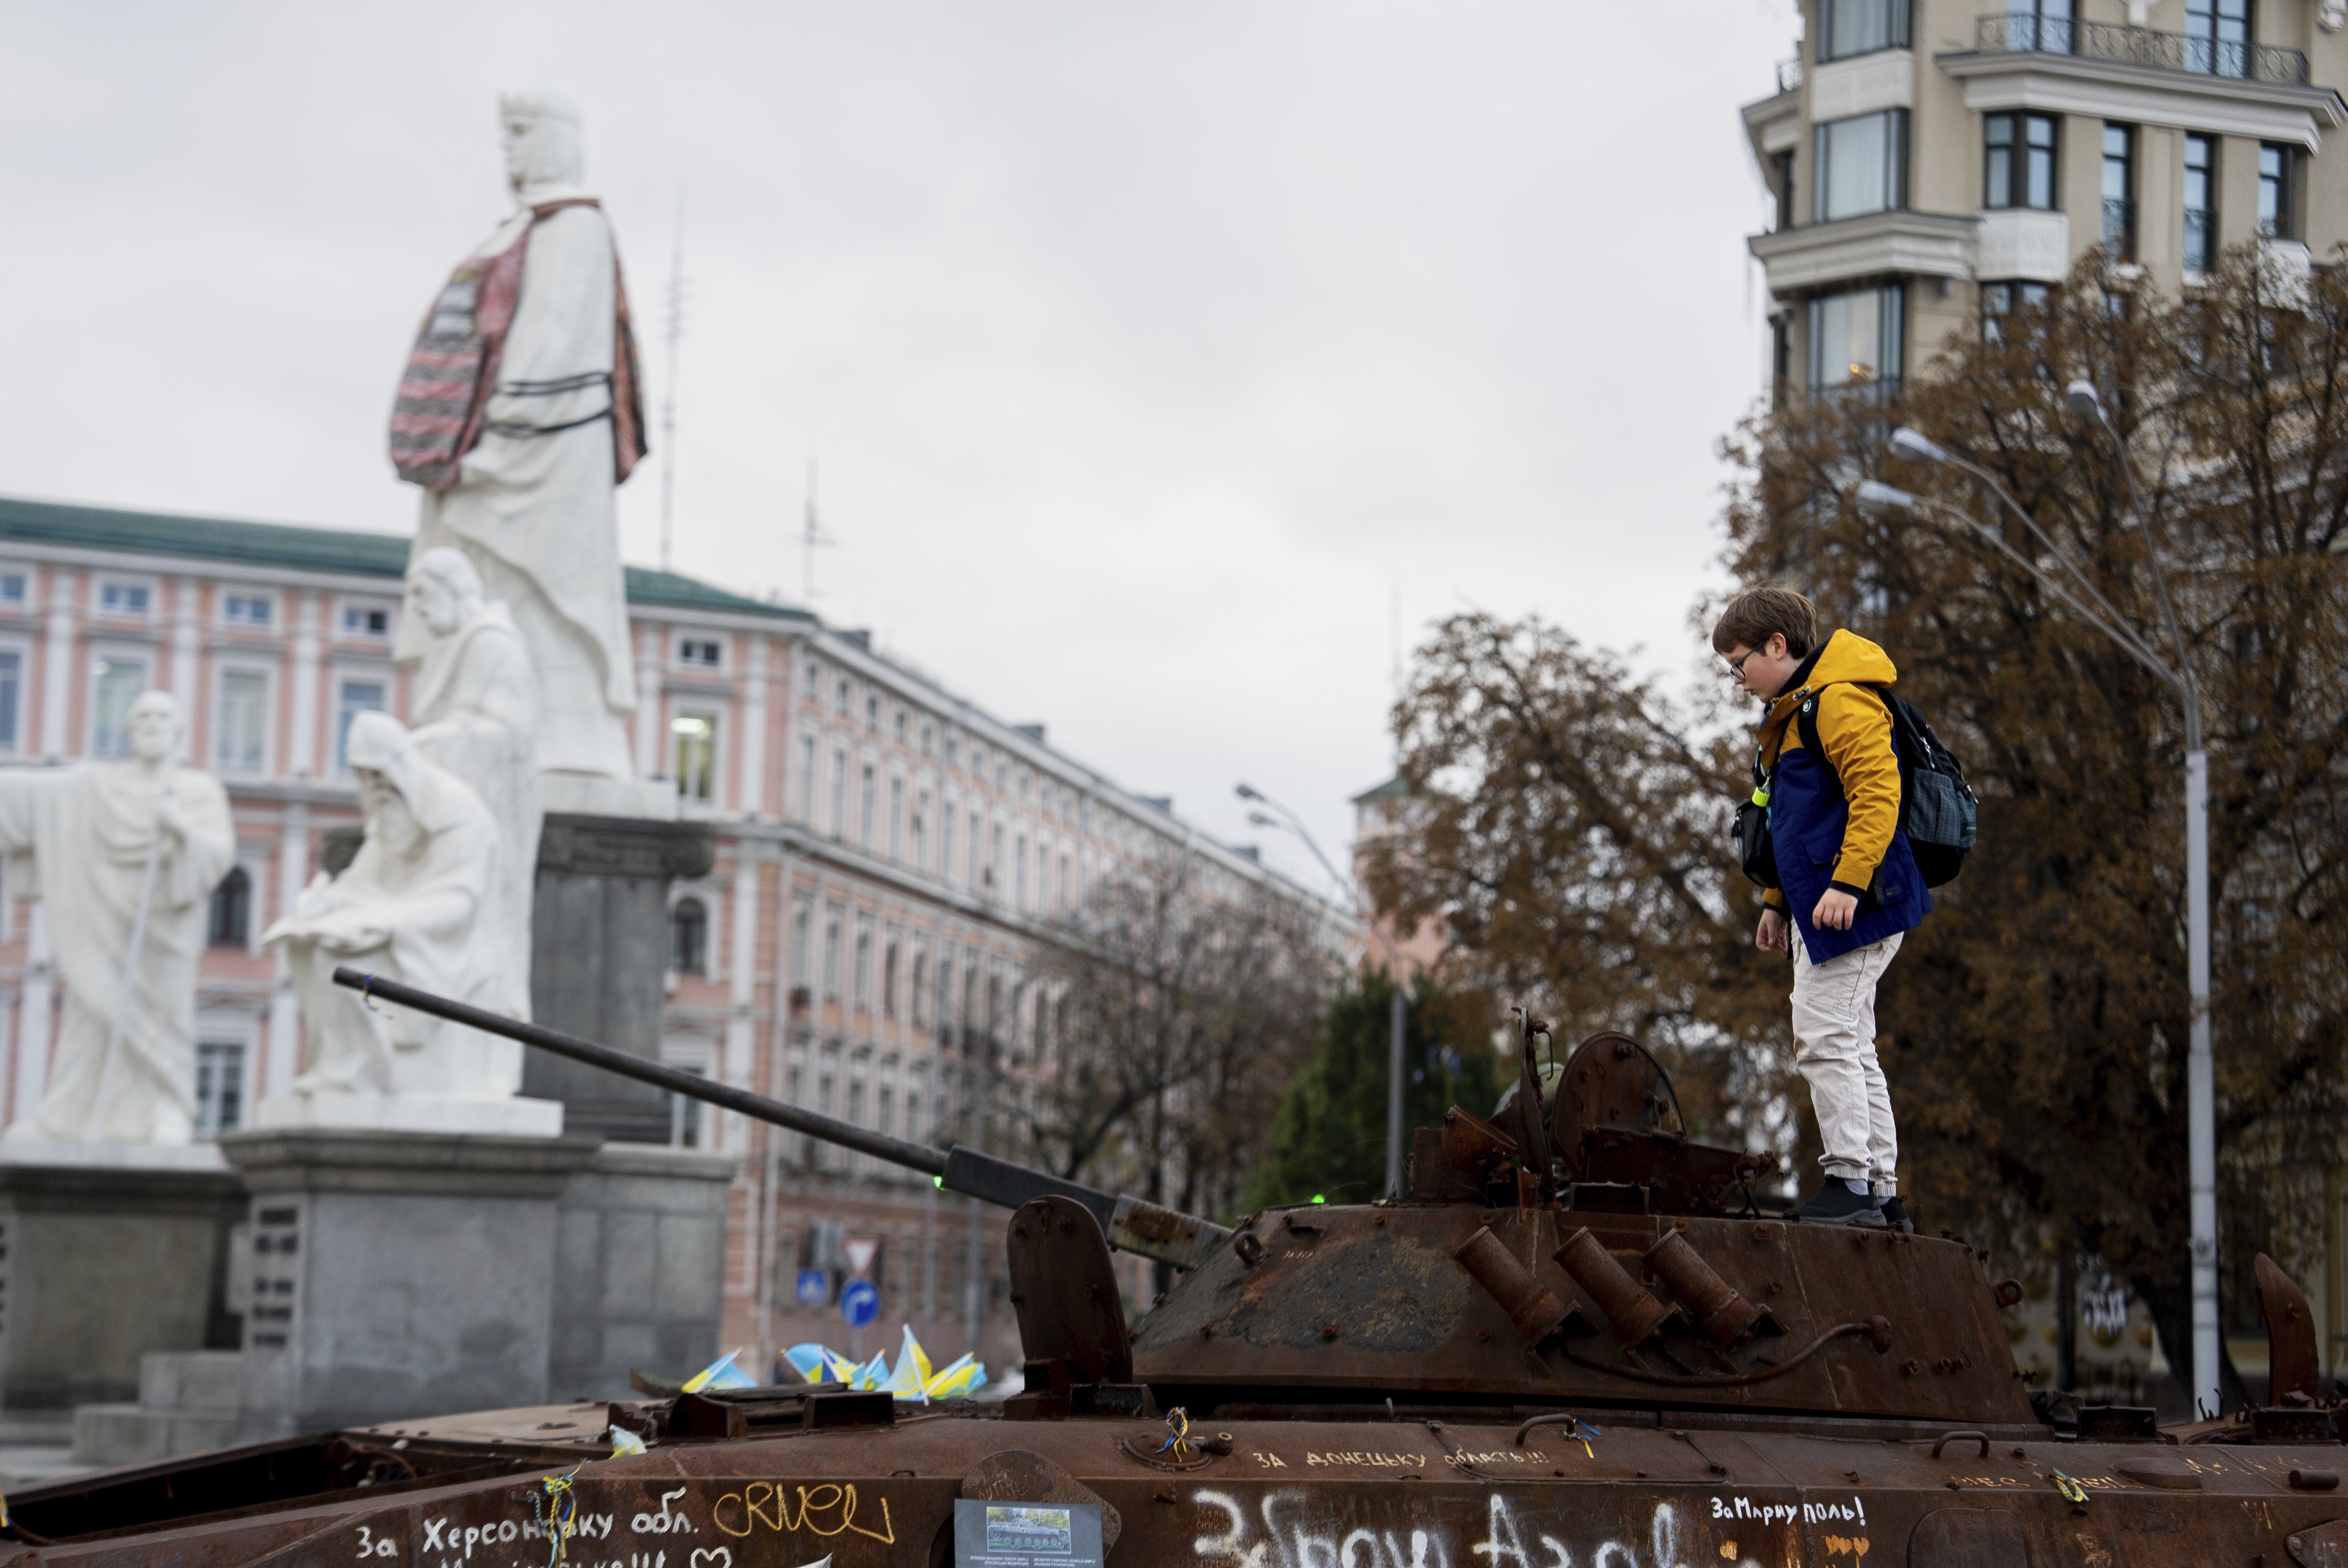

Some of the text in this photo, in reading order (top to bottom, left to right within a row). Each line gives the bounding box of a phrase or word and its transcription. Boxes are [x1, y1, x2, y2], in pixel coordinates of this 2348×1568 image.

[1253, 1452, 1288, 1468] ЗА
[1306, 1451, 1427, 1468] ДОНЕЦЬКУ
[356, 1525, 399, 1559] За
[631, 1487, 699, 1534] обл.
